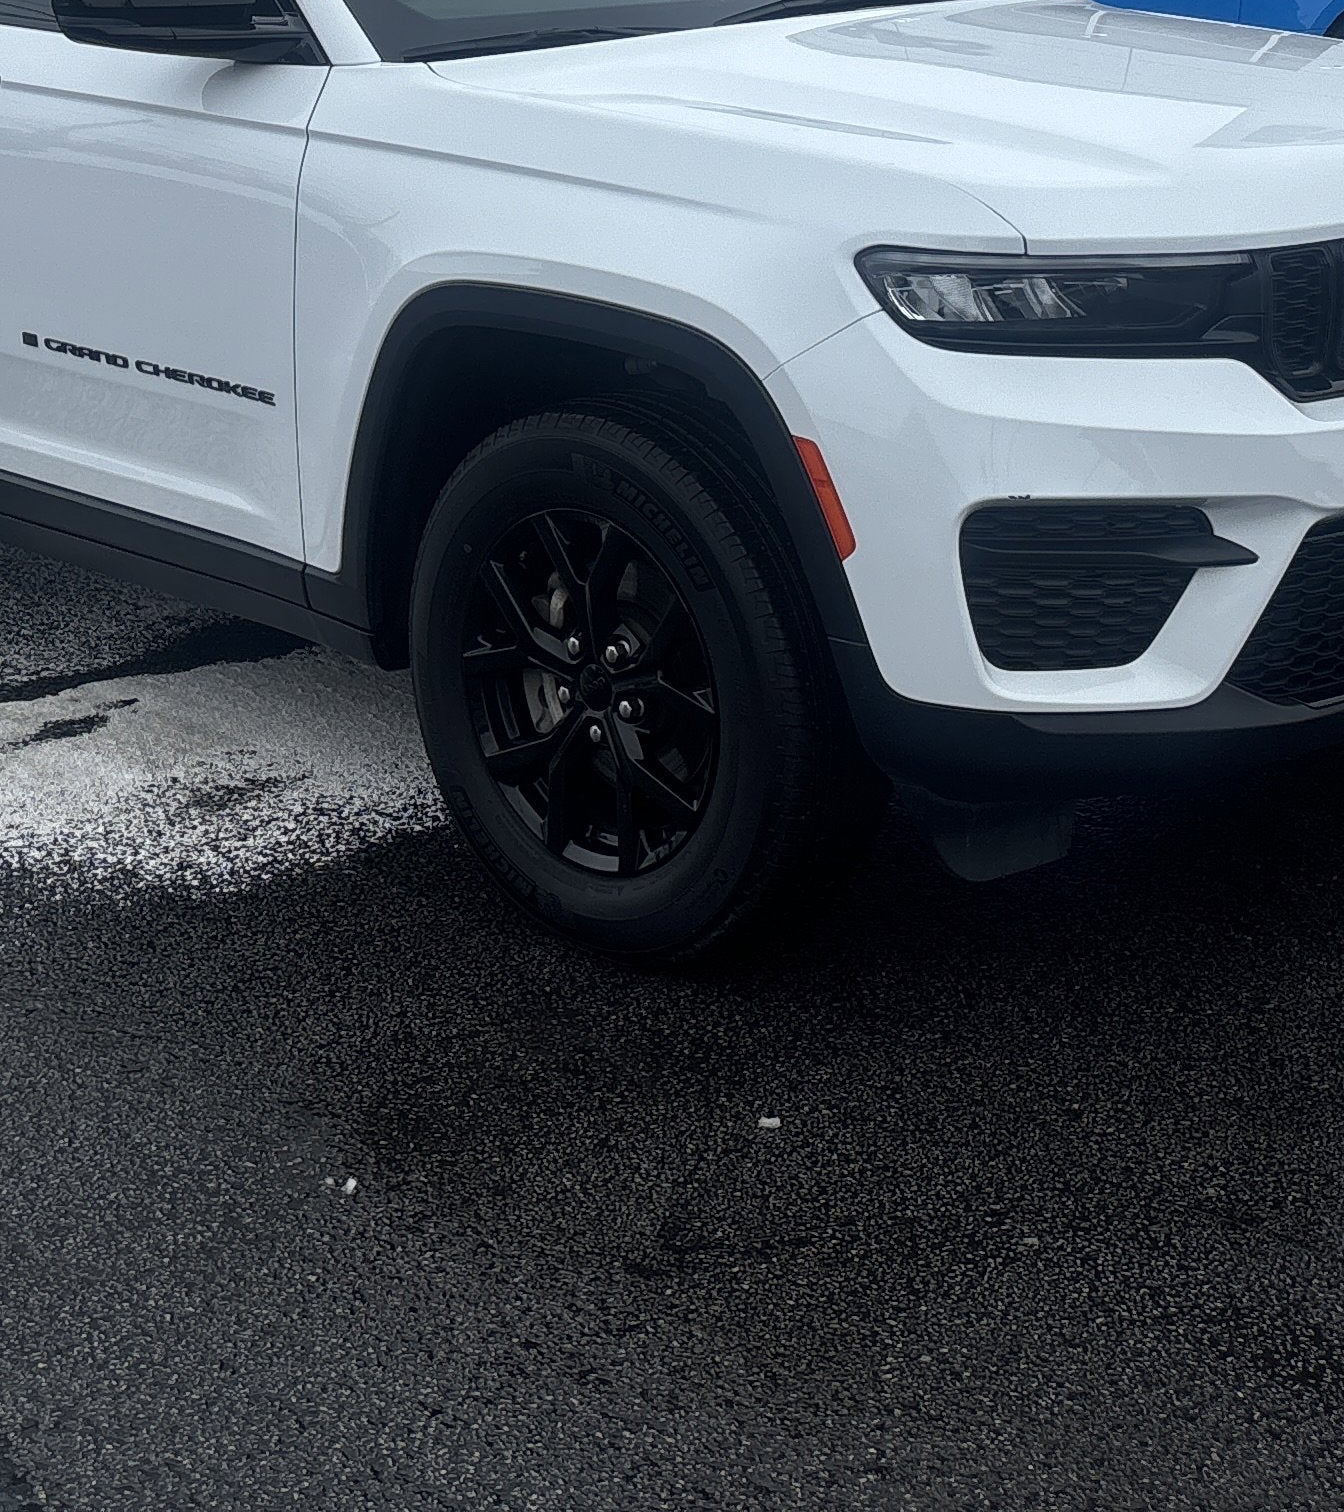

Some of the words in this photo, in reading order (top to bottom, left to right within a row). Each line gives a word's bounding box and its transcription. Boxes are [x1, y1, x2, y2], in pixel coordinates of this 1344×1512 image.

[43, 337, 130, 370] GRAND
[134, 359, 276, 407] CHEROKEE
[616, 480, 711, 587] MICHELIN
